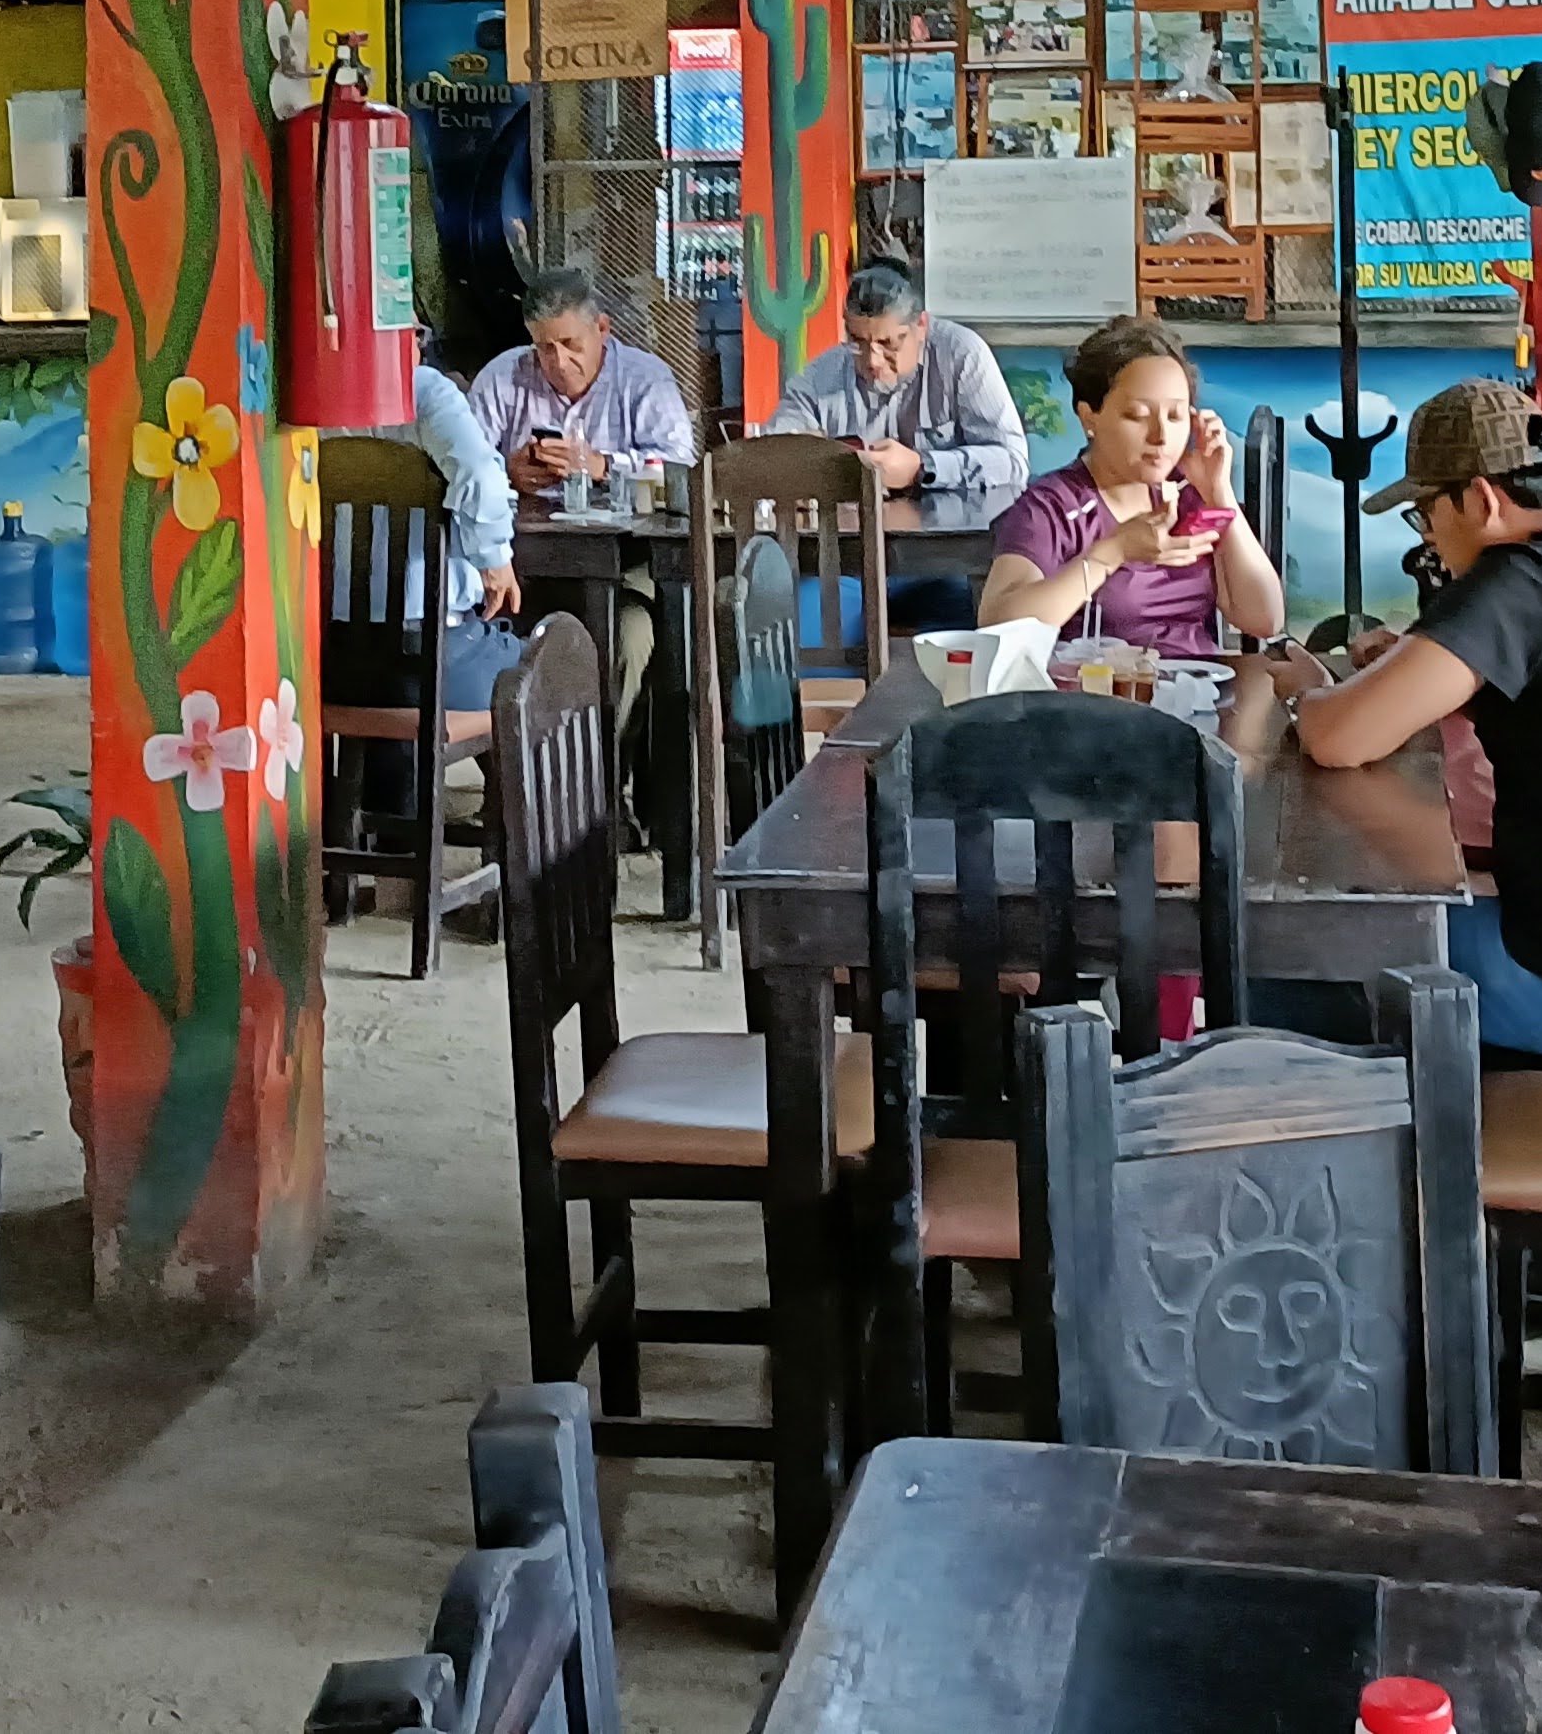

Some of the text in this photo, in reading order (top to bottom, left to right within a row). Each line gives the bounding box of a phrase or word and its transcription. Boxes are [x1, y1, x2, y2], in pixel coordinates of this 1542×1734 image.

[407, 81, 512, 110] Corona
[1347, 68, 1525, 115] IERCO
[1354, 124, 1481, 170] EY SEC
[1364, 219, 1423, 246] COBRA
[1426, 215, 1527, 245] DESCORCHE
[1355, 262, 1377, 288] OR
[1379, 261, 1403, 288] SU
[1405, 259, 1479, 287] VALIOSA
